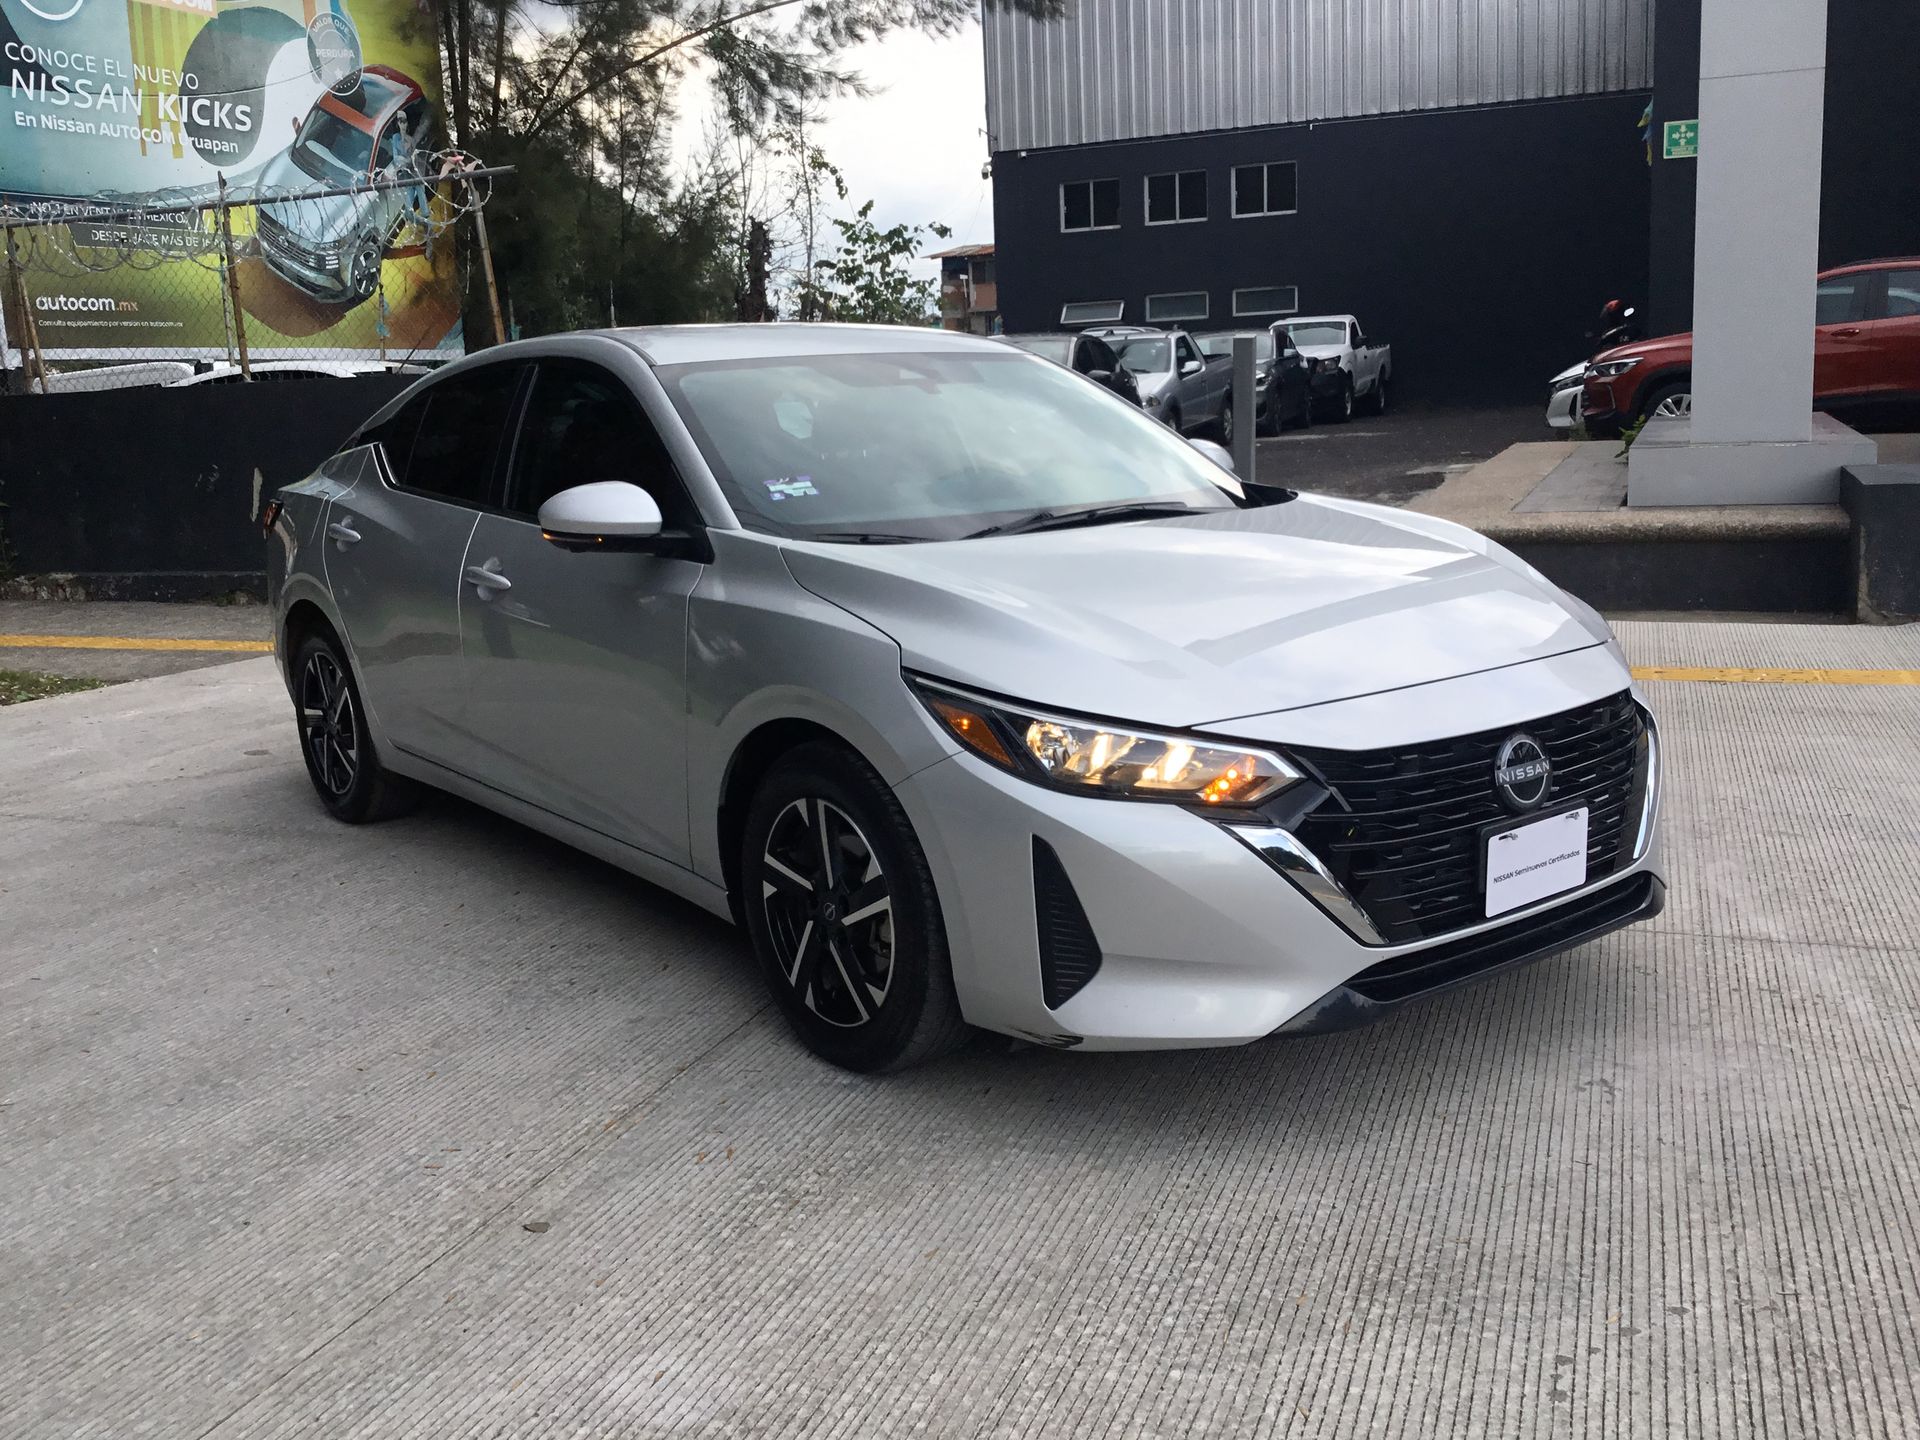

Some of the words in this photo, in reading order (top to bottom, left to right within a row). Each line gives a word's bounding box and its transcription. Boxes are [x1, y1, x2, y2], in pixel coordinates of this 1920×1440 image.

[334, 19, 350, 36] QUE
[315, 48, 355, 58] PERDURA
[4, 42, 97, 73] CONOCE
[103, 58, 127, 78] EL
[133, 63, 199, 90] NUEVO
[11, 68, 142, 116] NISSAN
[157, 91, 252, 132] KICKS
[14, 110, 37, 127] En
[40, 114, 96, 135] Nissan
[35, 294, 139, 312] autocom.mx
[1499, 759, 1550, 784] NISSAN
[1493, 871, 1514, 883] NISSAN
[1514, 859, 1548, 877] Seminuevos
[1548, 849, 1580, 865] Certificados
